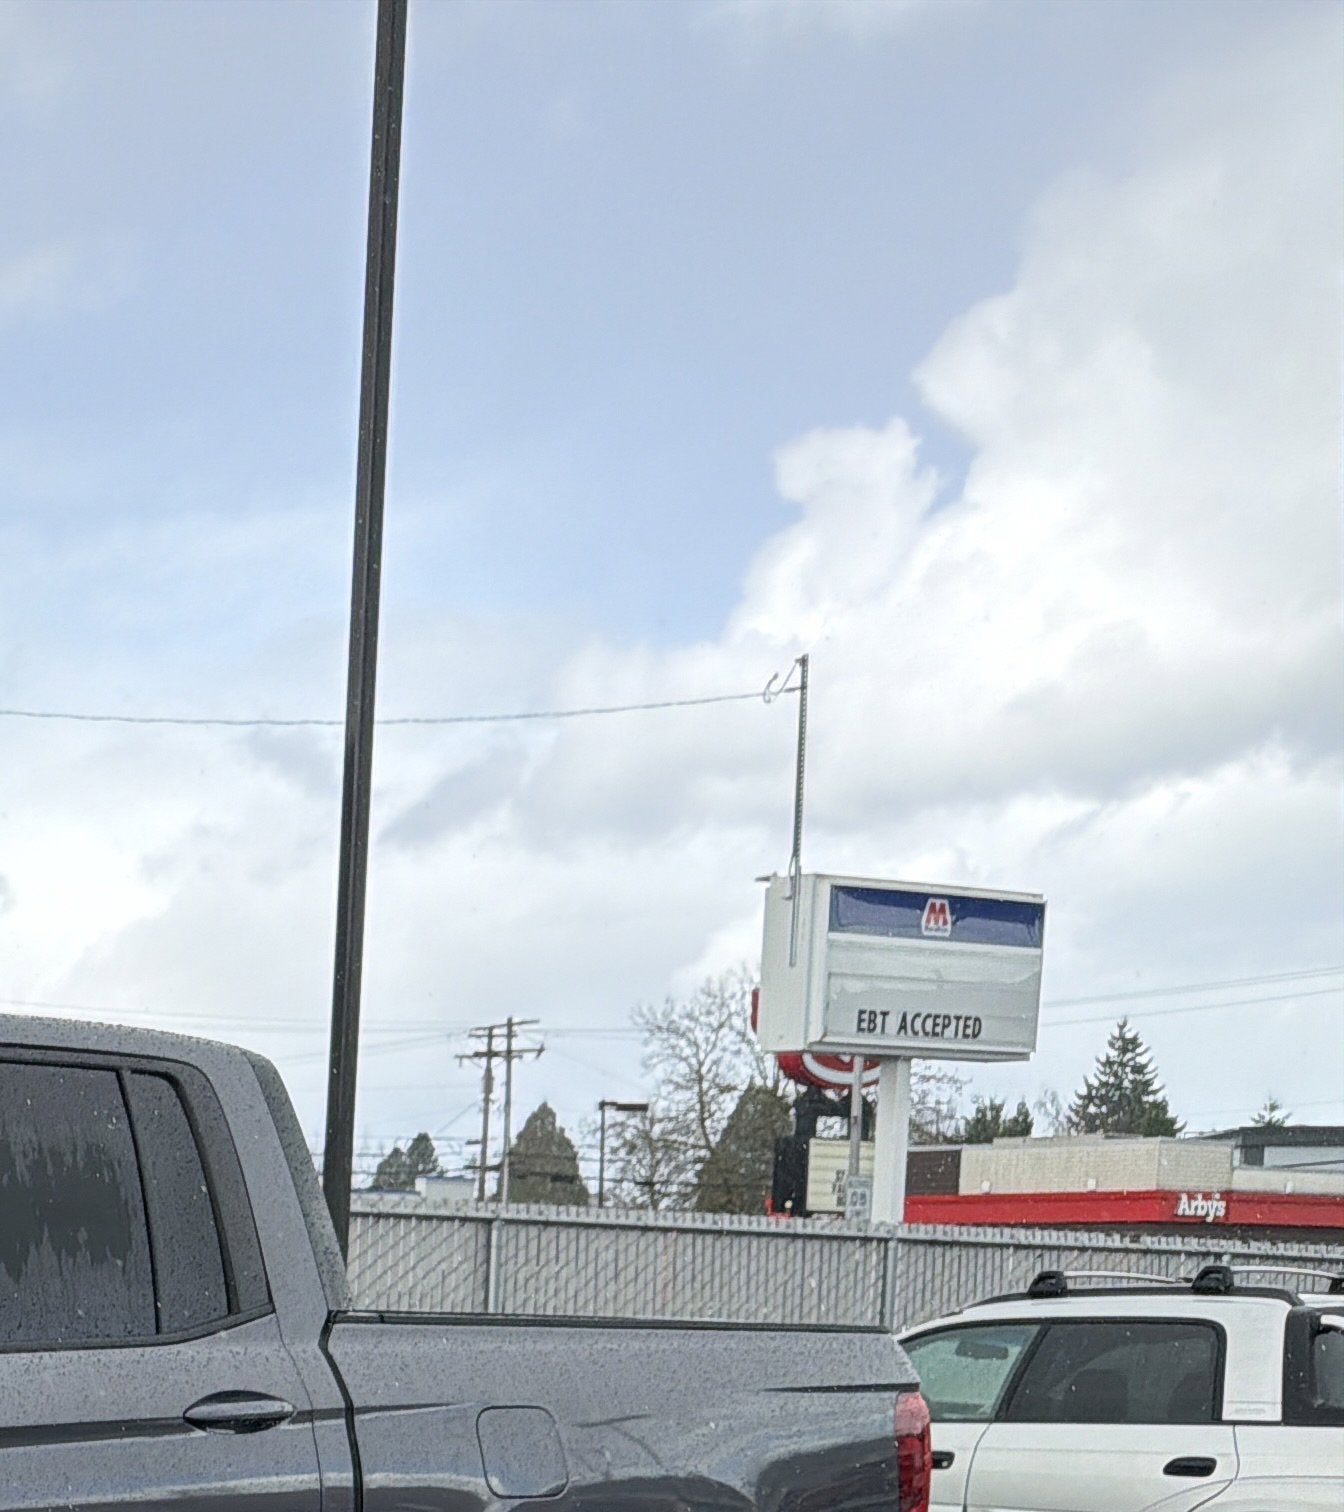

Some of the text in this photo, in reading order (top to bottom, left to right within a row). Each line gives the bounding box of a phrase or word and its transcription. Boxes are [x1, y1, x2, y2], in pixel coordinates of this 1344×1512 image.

[856, 1009, 982, 1039] EBT ACCEPTED
[1177, 1192, 1226, 1223] Arby's
